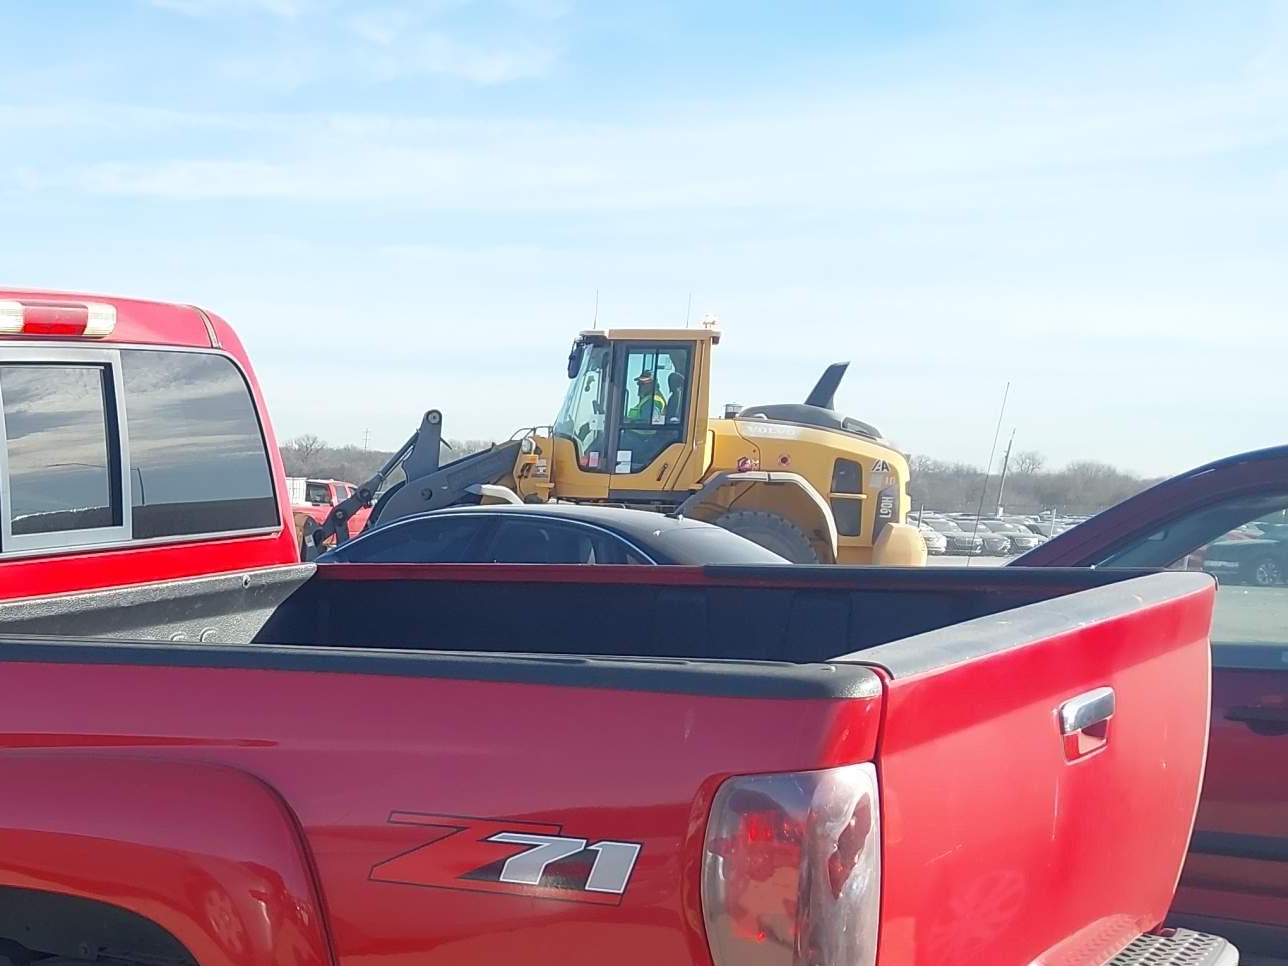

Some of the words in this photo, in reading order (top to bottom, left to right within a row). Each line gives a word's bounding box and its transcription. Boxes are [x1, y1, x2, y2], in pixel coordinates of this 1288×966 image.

[749, 424, 796, 436] VOLVO
[879, 496, 894, 518] L90H
[367, 809, 644, 907] Z71
